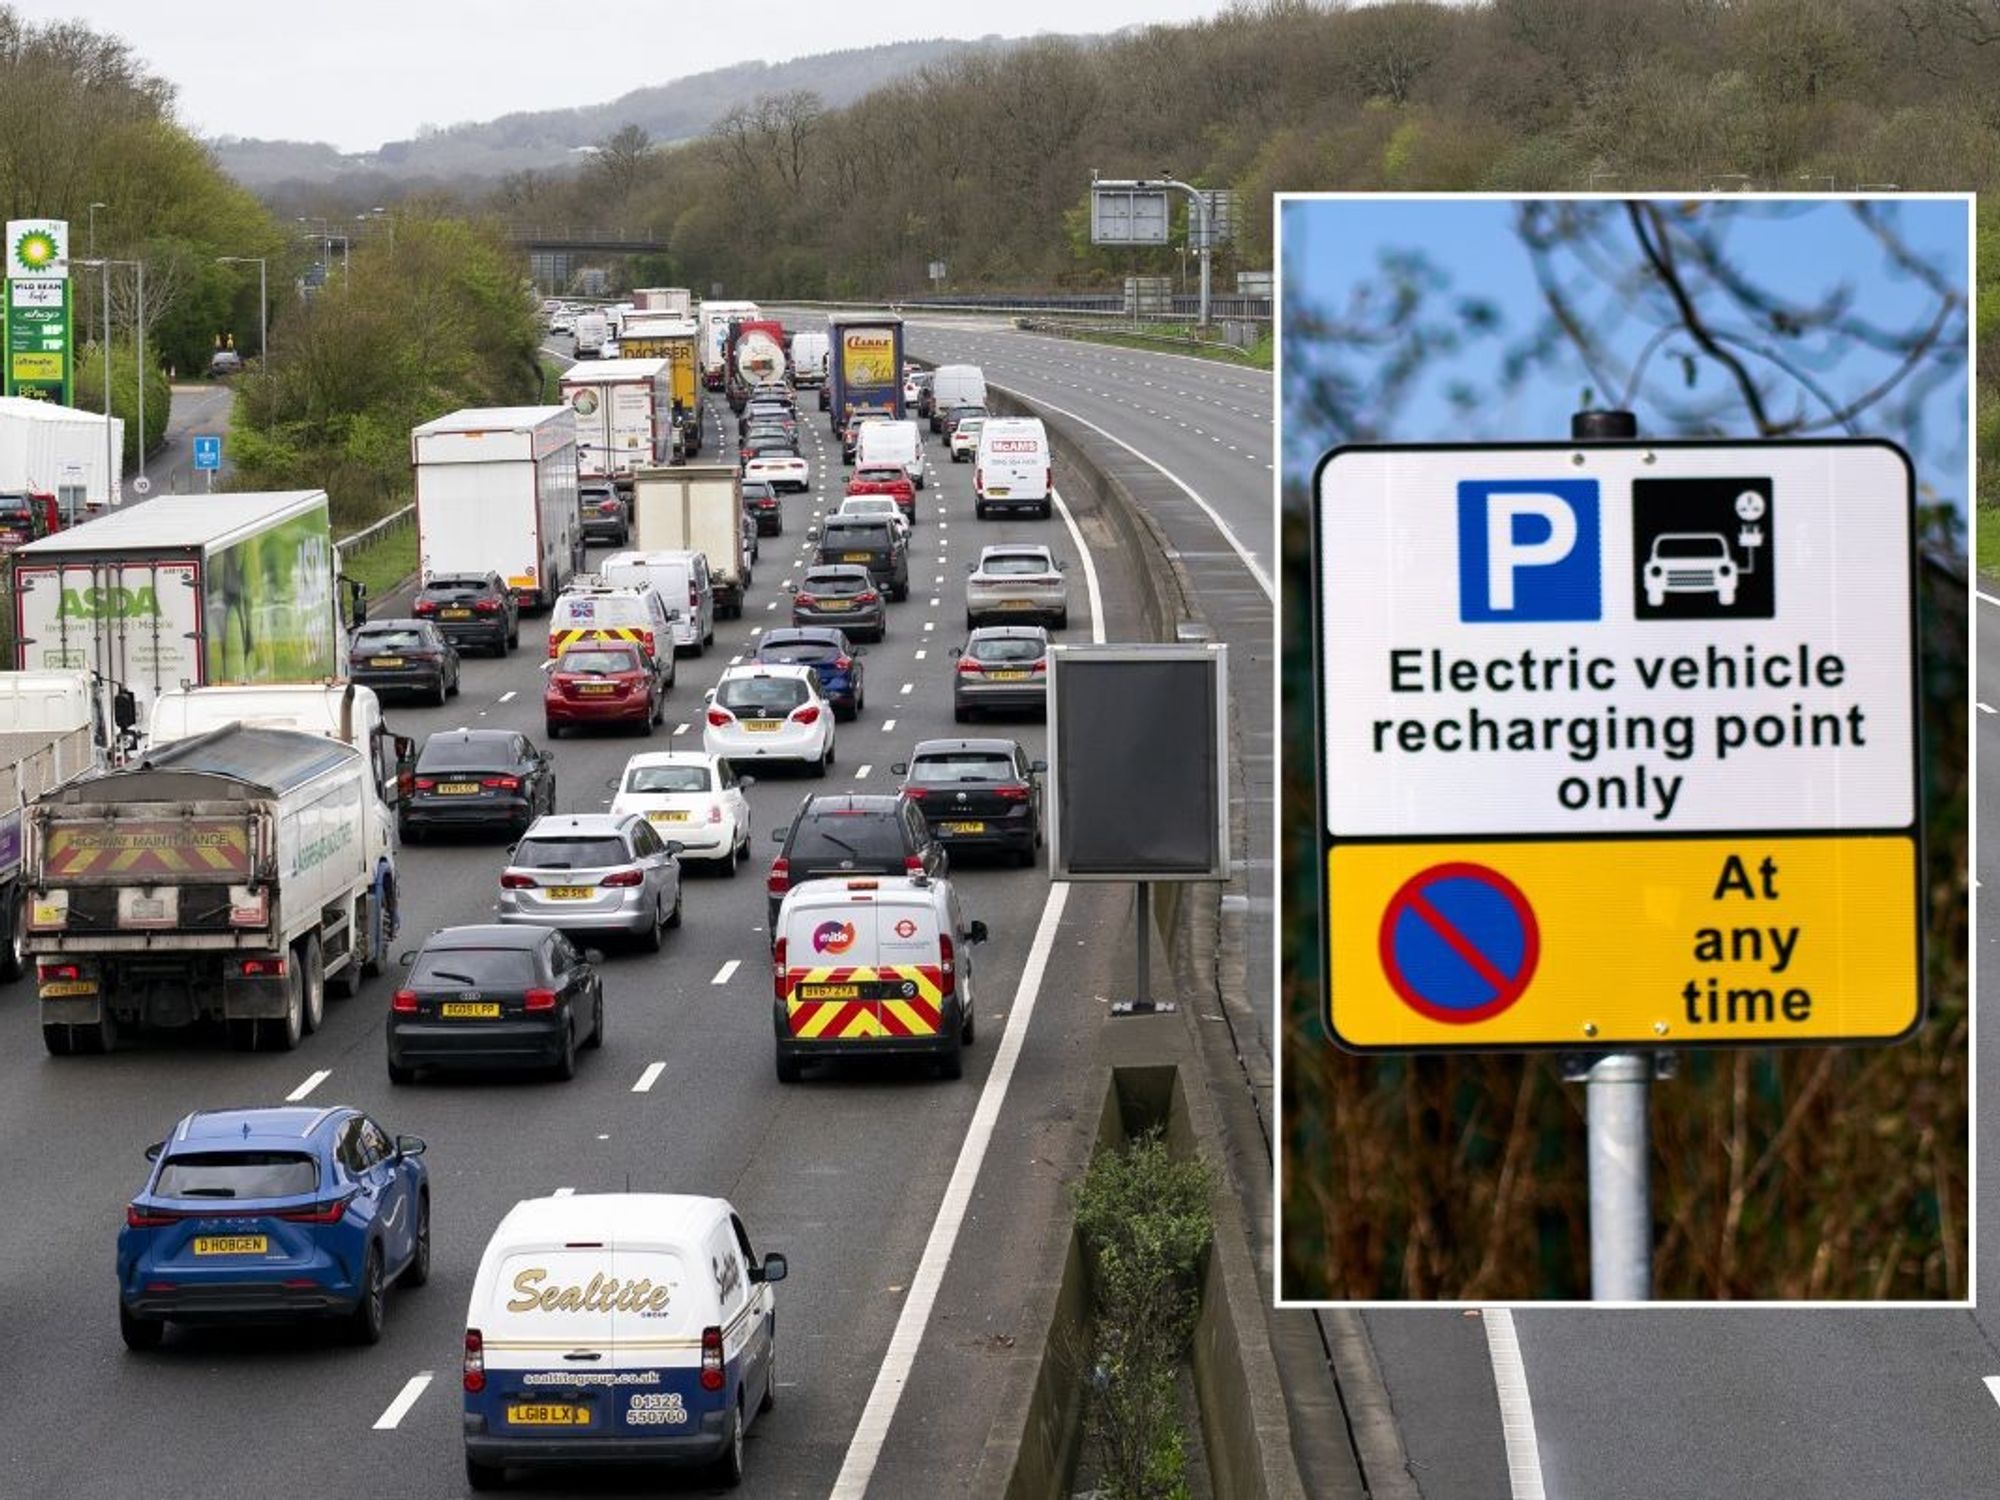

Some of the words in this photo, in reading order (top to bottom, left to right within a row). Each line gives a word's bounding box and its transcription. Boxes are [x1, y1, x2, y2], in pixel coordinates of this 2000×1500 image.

[1487, 492, 1576, 611] P
[56, 586, 162, 620] ASDA
[1390, 648, 1615, 692] Electric
[1634, 643, 1844, 689] vehicle
[1373, 706, 1693, 761] recharging
[1717, 703, 1866, 759] point
[1557, 764, 1683, 820] only
[1714, 855, 1778, 900] At
[1694, 926, 1799, 973] any
[1682, 977, 1812, 1023] time
[506, 1268, 670, 1313] Sealtite
[631, 1394, 682, 1409] 01322
